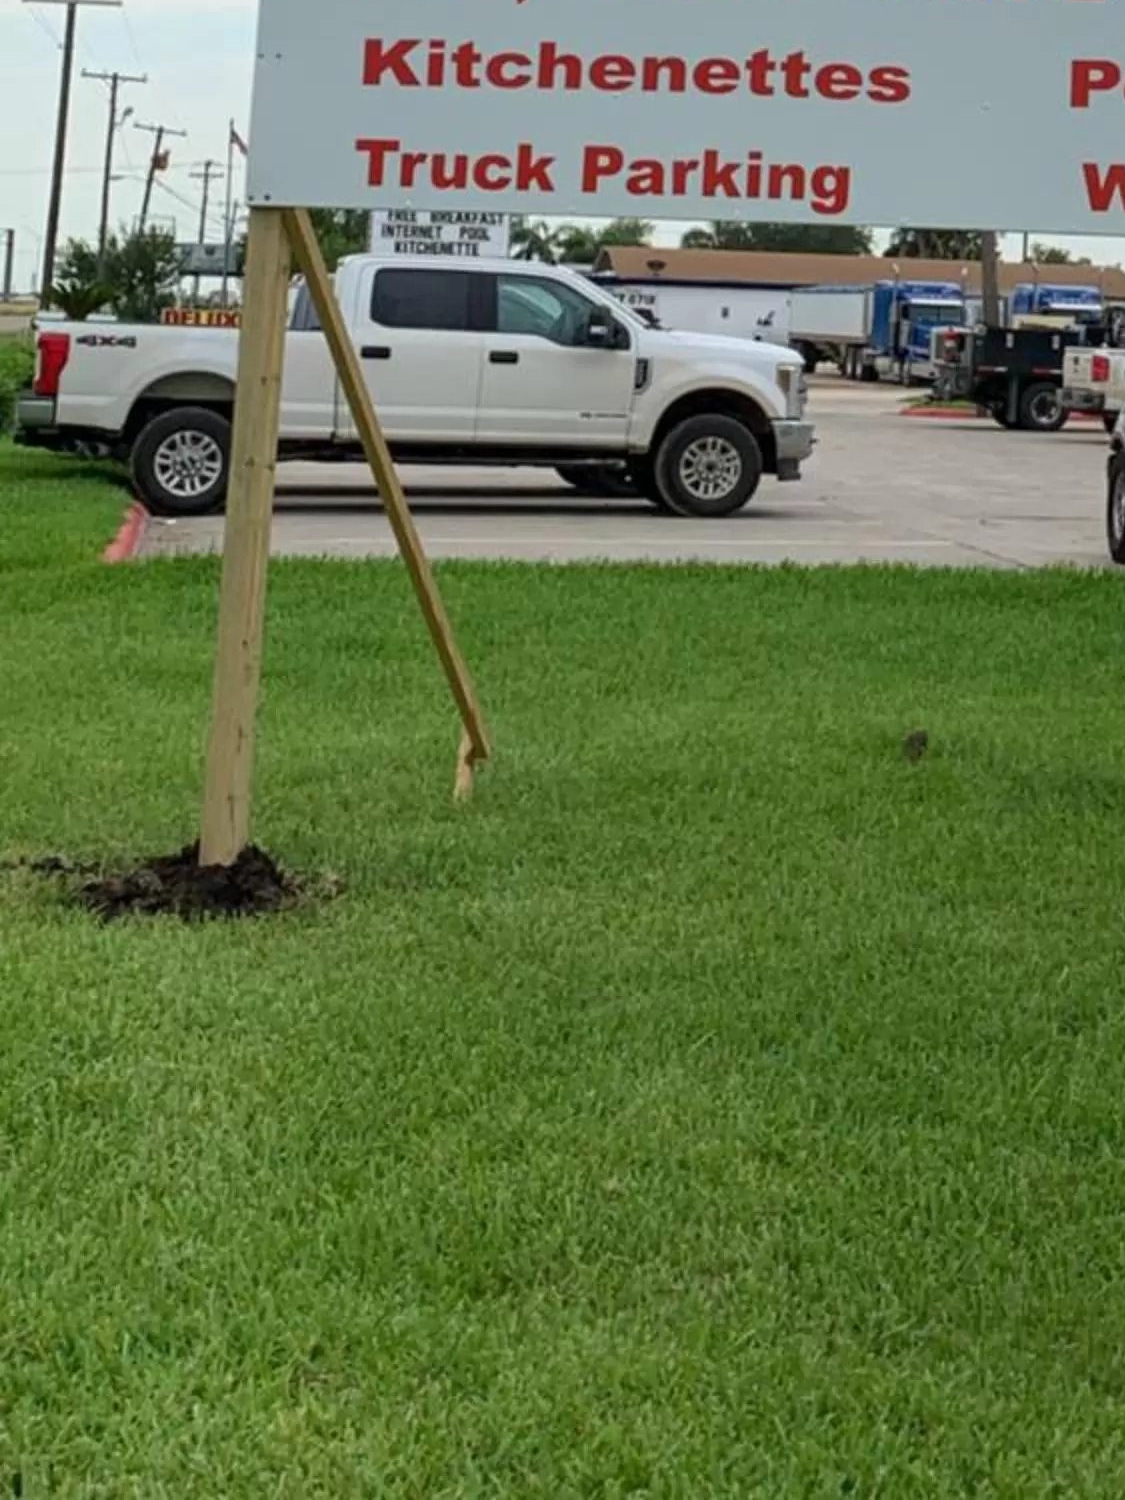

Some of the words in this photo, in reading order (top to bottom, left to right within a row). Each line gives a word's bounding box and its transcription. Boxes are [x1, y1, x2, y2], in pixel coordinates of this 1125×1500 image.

[362, 37, 911, 103] Kitchenettes
[355, 139, 556, 192] Truck
[581, 145, 851, 215] Parking
[387, 208, 418, 222] FREE
[429, 210, 504, 225] BREAKFAST
[381, 223, 443, 240] INTERNET
[458, 225, 491, 242] POOL
[393, 240, 480, 257] KITCHENETTE
[164, 309, 242, 328] DELUX
